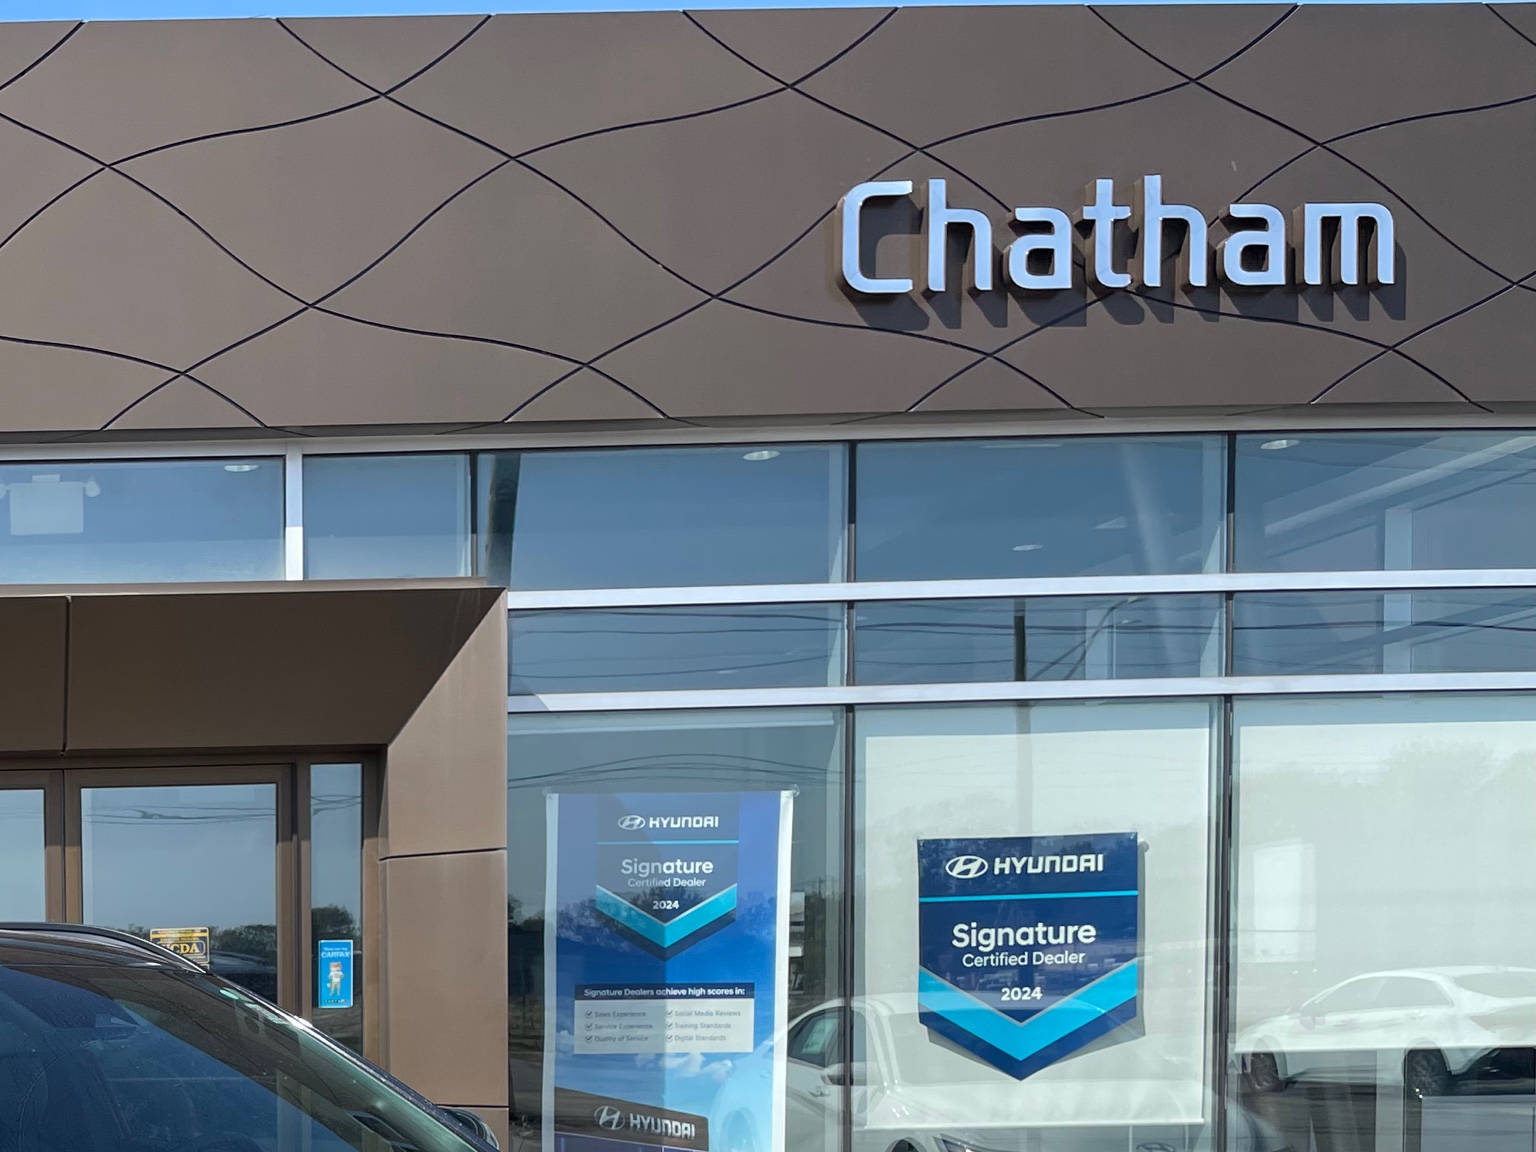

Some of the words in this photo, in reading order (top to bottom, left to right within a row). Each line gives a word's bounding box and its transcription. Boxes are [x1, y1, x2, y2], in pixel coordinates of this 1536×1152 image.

[839, 174, 1395, 294] Chatham
[649, 816, 719, 828] HYUNDAI
[621, 858, 714, 877] Signature
[993, 854, 1104, 875] HYUNDAI
[628, 878, 670, 887] Certified
[673, 878, 706, 887] Dealer
[652, 900, 680, 909] 2024
[952, 922, 1097, 952] Signature
[162, 943, 200, 954] CDA
[962, 951, 1028, 967] Certified
[1032, 950, 1086, 965] Dealer
[584, 988, 623, 997] Signature
[624, 988, 654, 996] Dealers
[656, 987, 687, 996] achieve
[688, 987, 706, 997] high
[707, 988, 734, 996] scores
[735, 986, 746, 996] in:
[1000, 986, 1043, 1001] 2024
[630, 1112, 696, 1139] HYUNDAI
